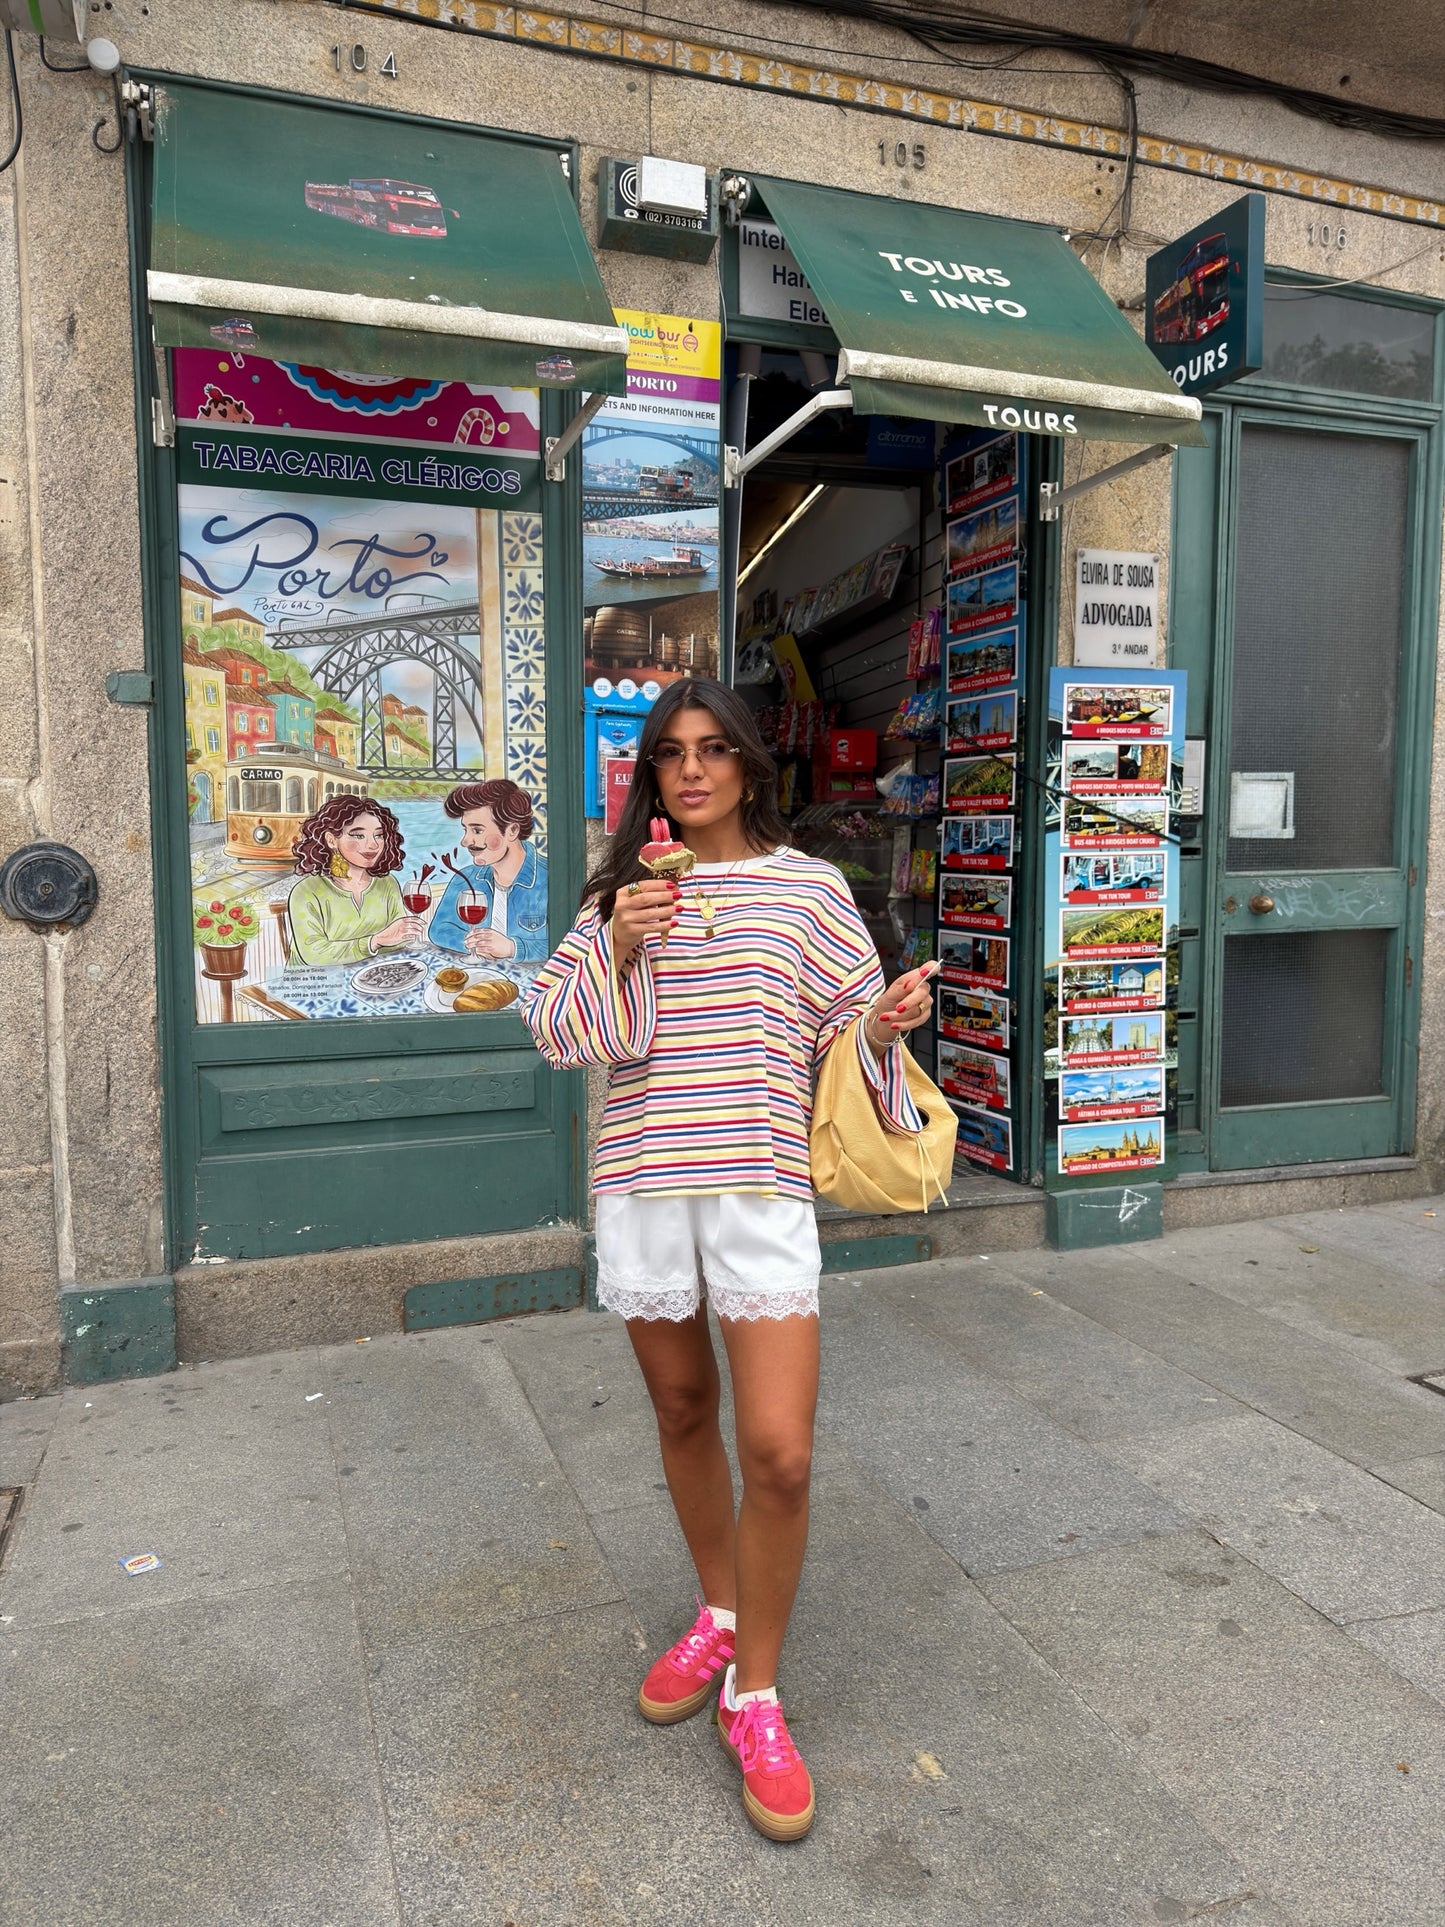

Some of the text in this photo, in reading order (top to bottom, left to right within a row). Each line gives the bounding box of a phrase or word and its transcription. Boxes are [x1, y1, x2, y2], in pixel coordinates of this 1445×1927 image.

[331, 43, 398, 79] 104
[878, 139, 926, 170] 105
[645, 212, 702, 229] (02) 3703168
[1307, 223, 1348, 250] 106
[878, 251, 1011, 287] TOURS
[900, 289, 1027, 318] E INFO
[620, 322, 680, 342] llow bus
[1167, 342, 1228, 388] OURS
[626, 374, 677, 392] PORTO
[620, 403, 637, 412] AND
[639, 404, 694, 419] INFORMATION
[695, 411, 716, 421] HERE
[983, 404, 1078, 434] TOURS
[193, 442, 521, 495] TABACARIA CLÉRIGOS
[180, 512, 450, 599] Porto
[1081, 562, 1155, 588] ELVIRA DE SOUSA
[254, 597, 318, 616] PORTUGAL
[1081, 603, 1153, 627] ADVOGADA
[1124, 643, 1149, 656] ANDAR
[241, 769, 282, 780] CARMO
[615, 773, 634, 783] EU
